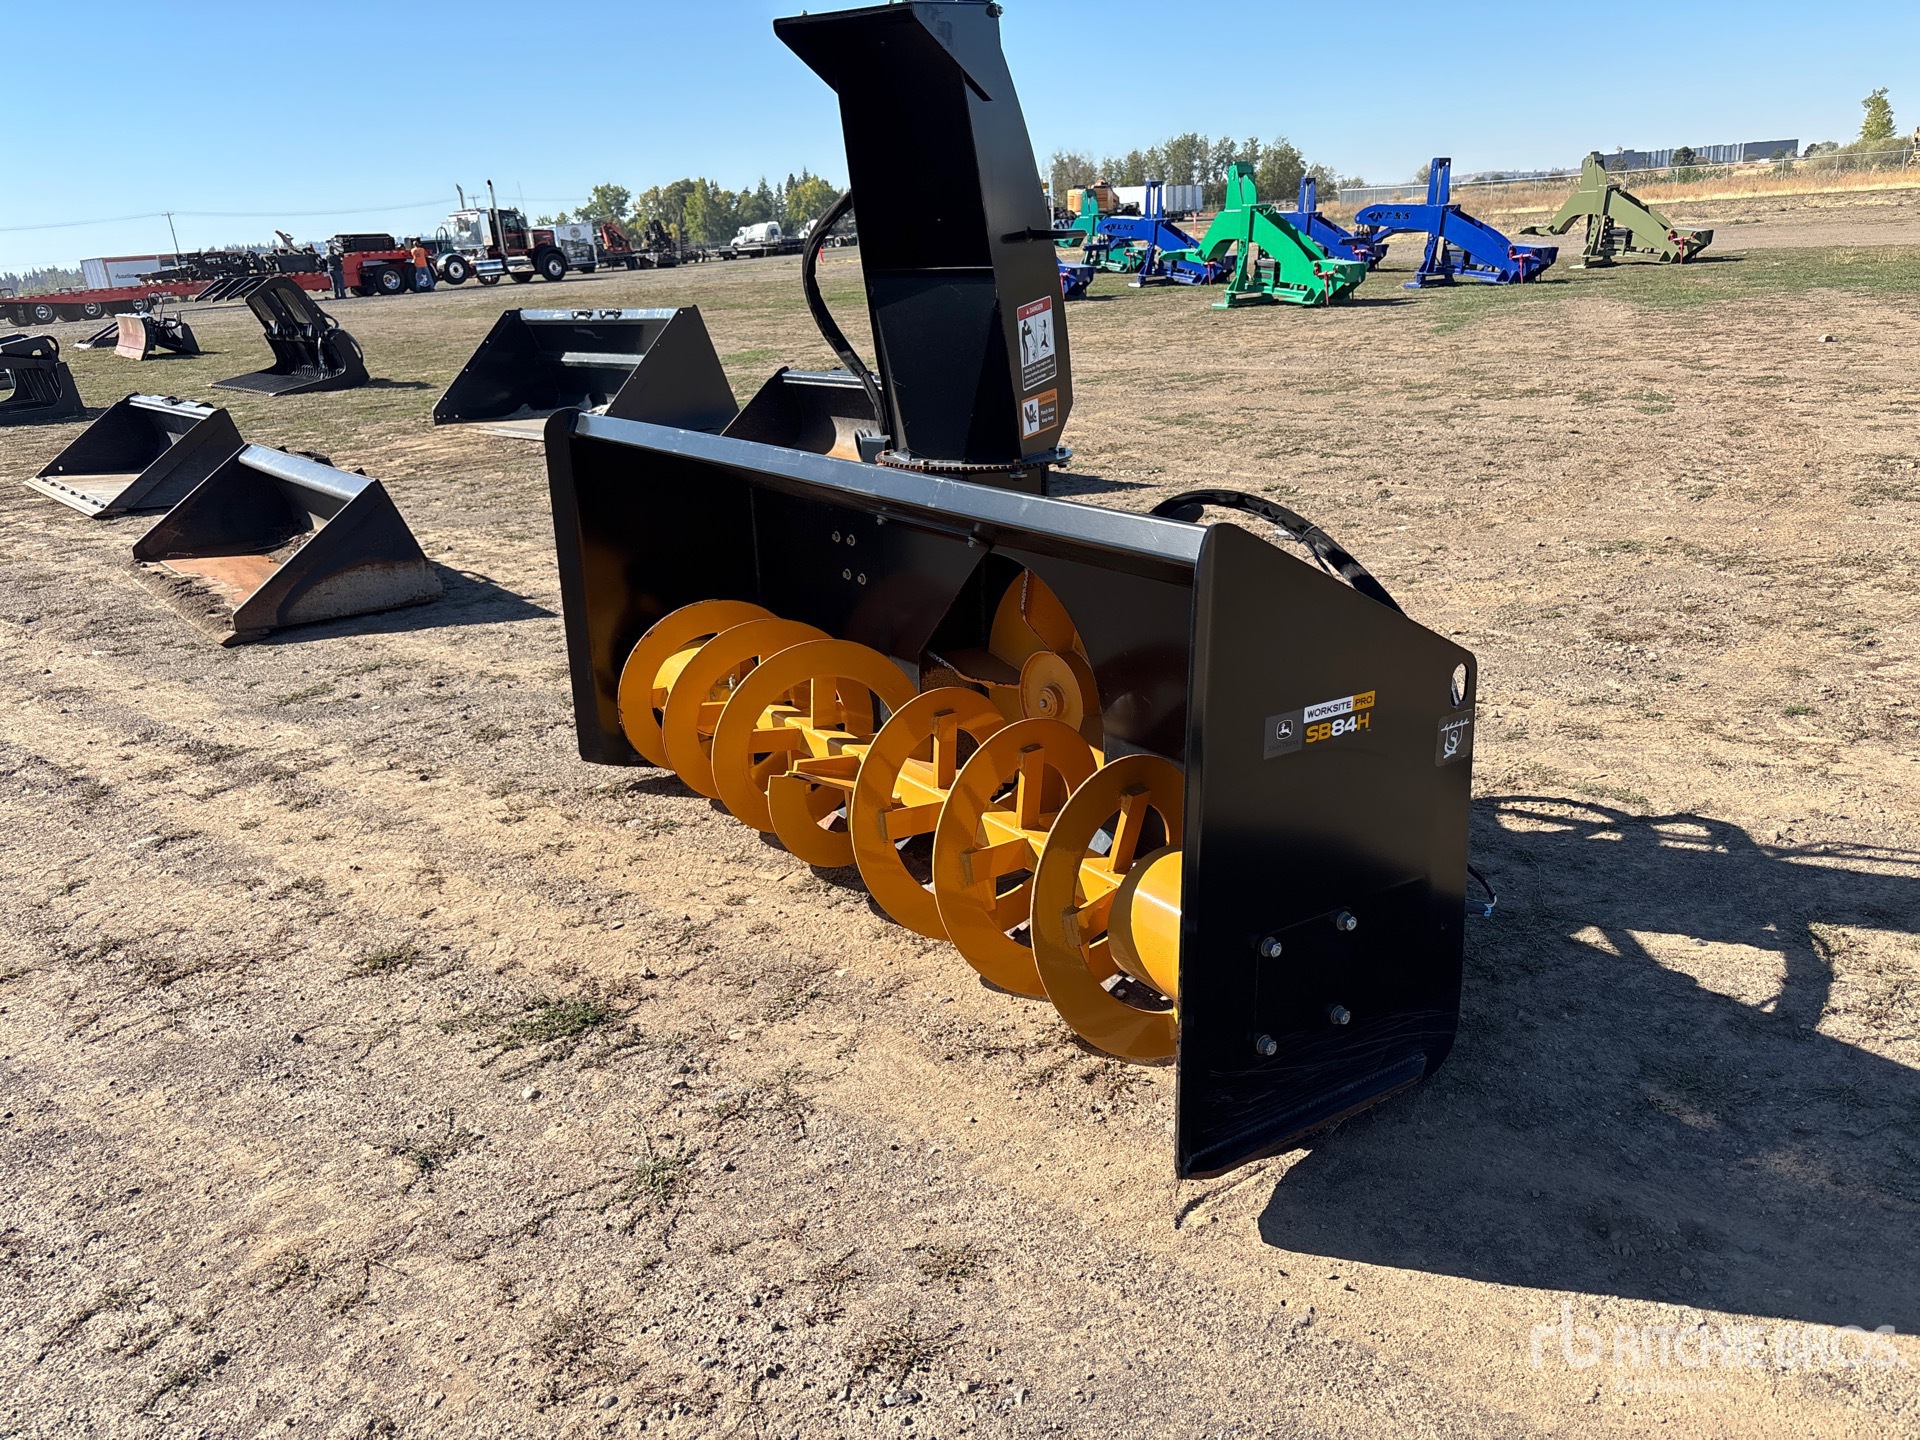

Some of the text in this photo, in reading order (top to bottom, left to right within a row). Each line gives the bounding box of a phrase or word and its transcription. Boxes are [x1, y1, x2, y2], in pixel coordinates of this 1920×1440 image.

[1029, 303, 1043, 313] DANGER
[1307, 695, 1373, 719] WORKSITE PRO
[1305, 712, 1370, 743] SB84H
